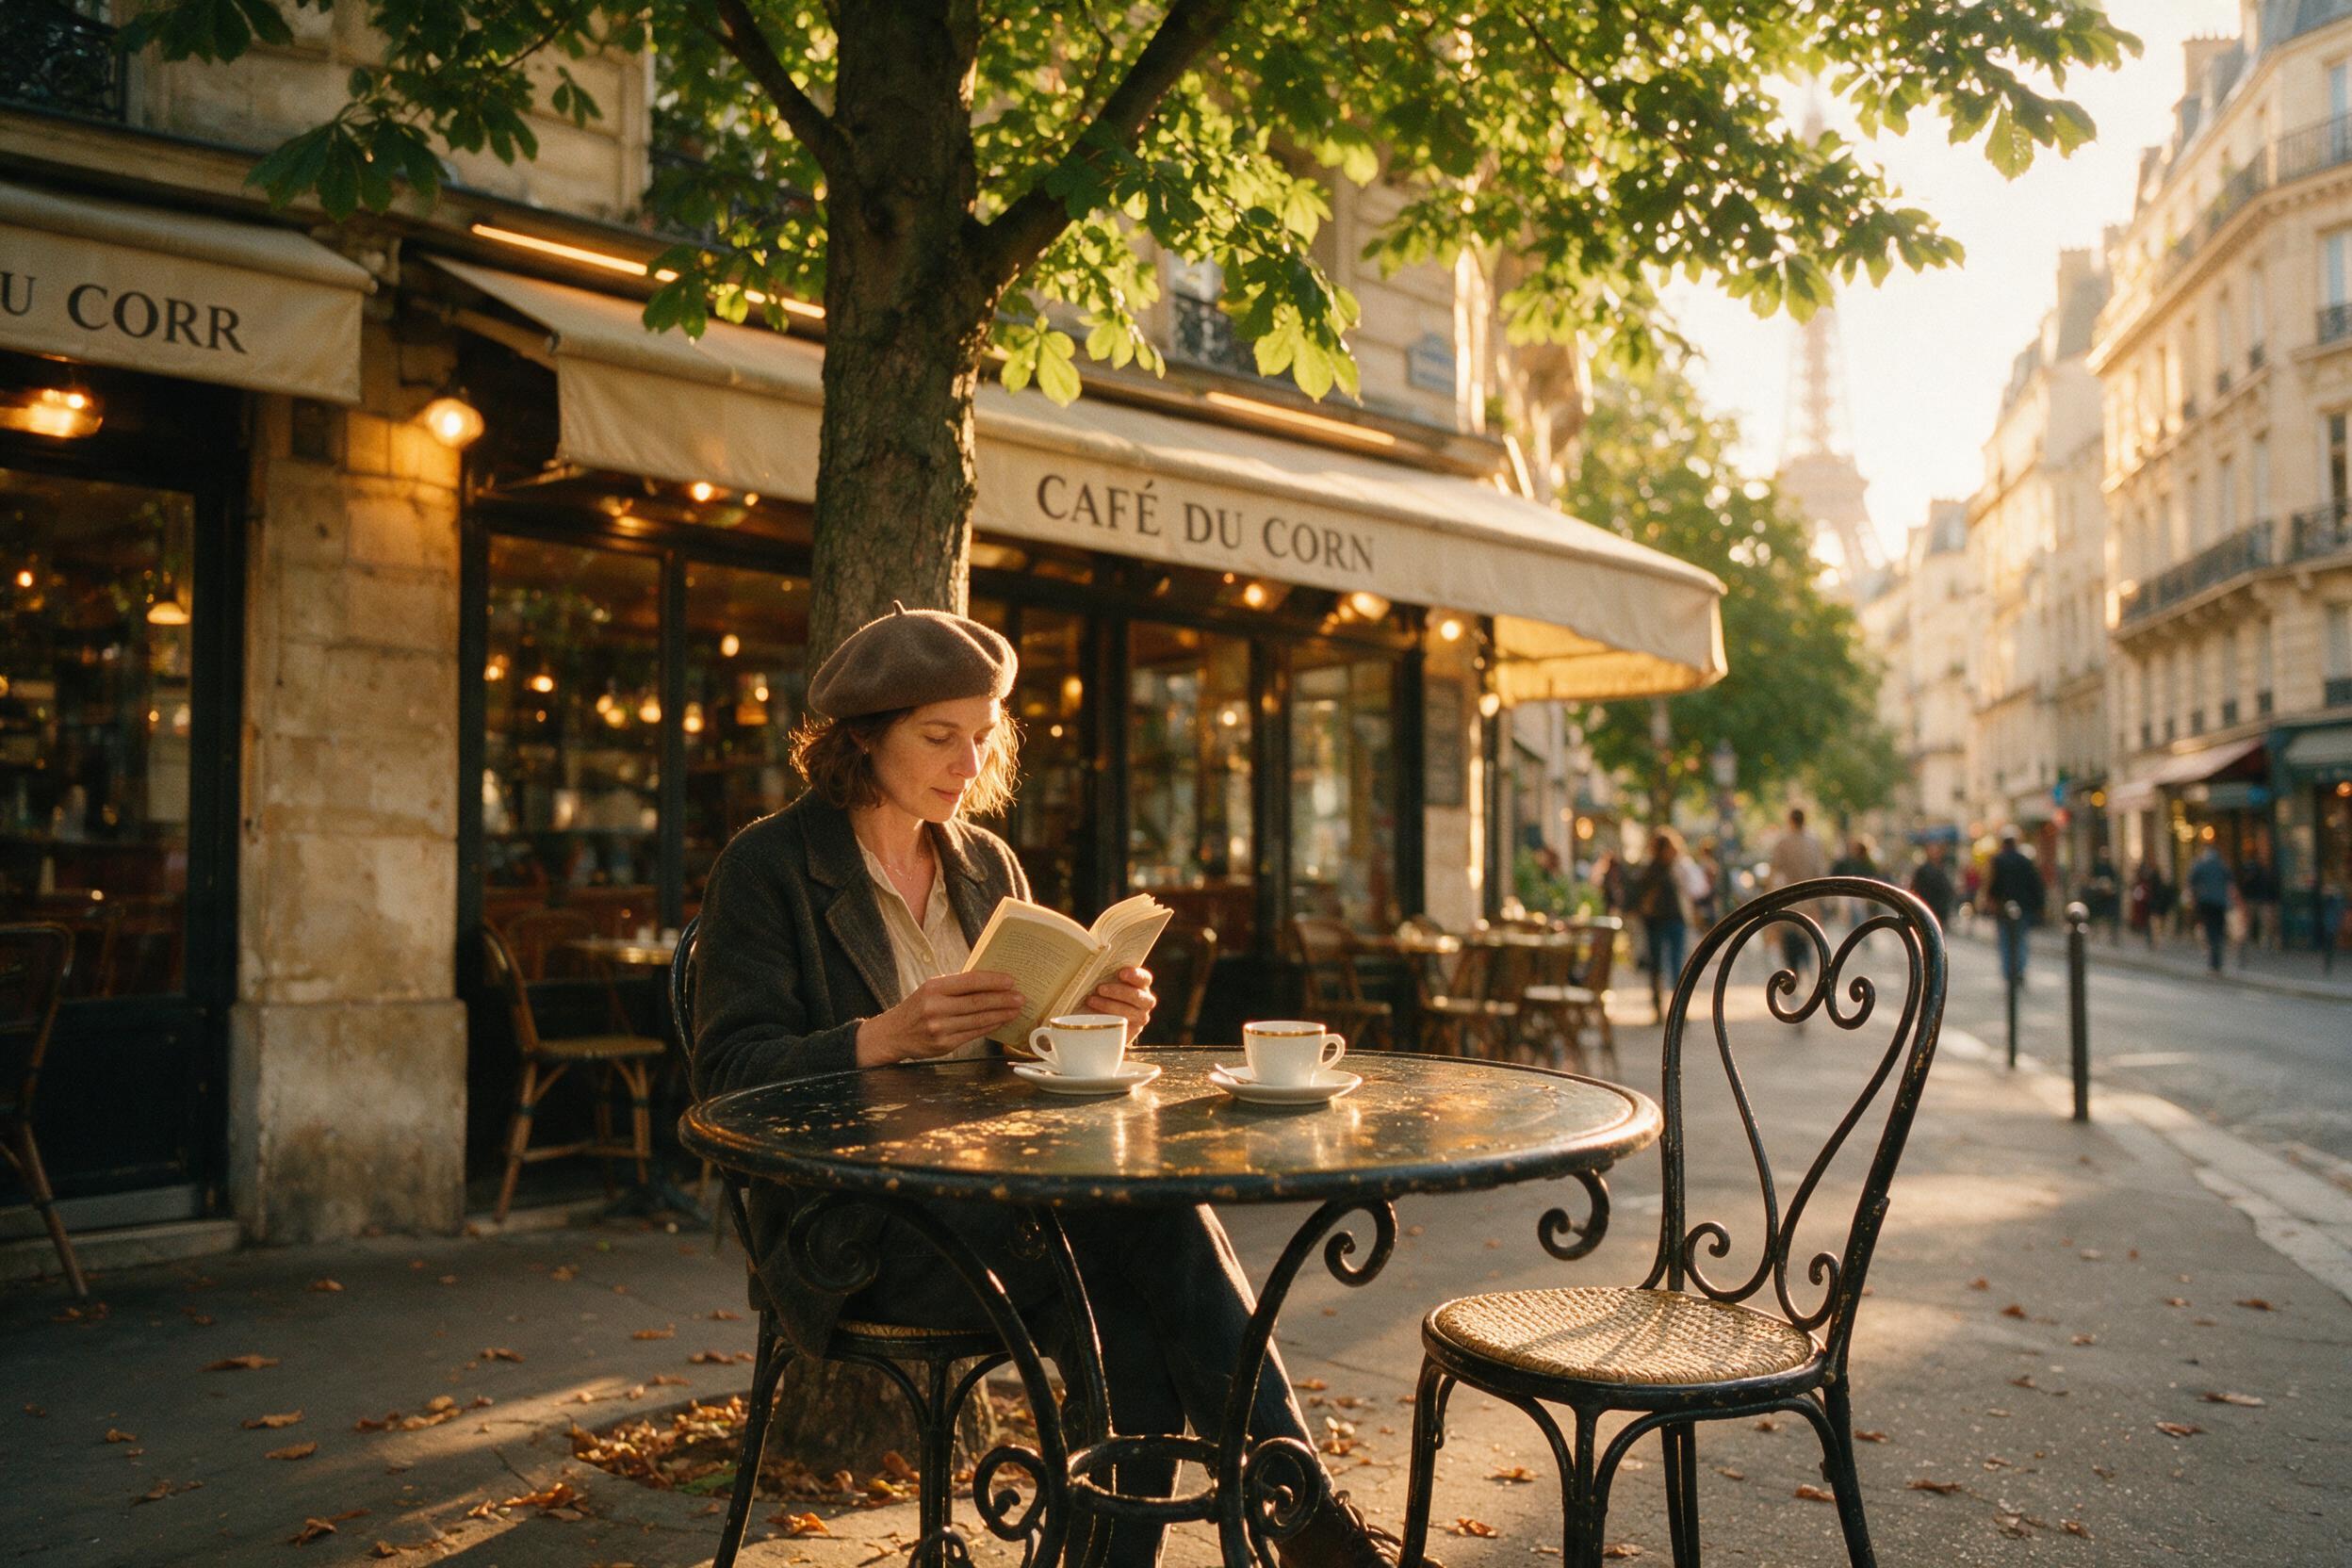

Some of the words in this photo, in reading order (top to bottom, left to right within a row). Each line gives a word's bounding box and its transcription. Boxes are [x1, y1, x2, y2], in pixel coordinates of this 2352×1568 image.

[0, 270, 36, 317] U
[67, 284, 248, 354] CORR
[1037, 474, 1160, 538] CAFÉ
[1184, 502, 1243, 549] DU
[1262, 515, 1374, 573] CORN
